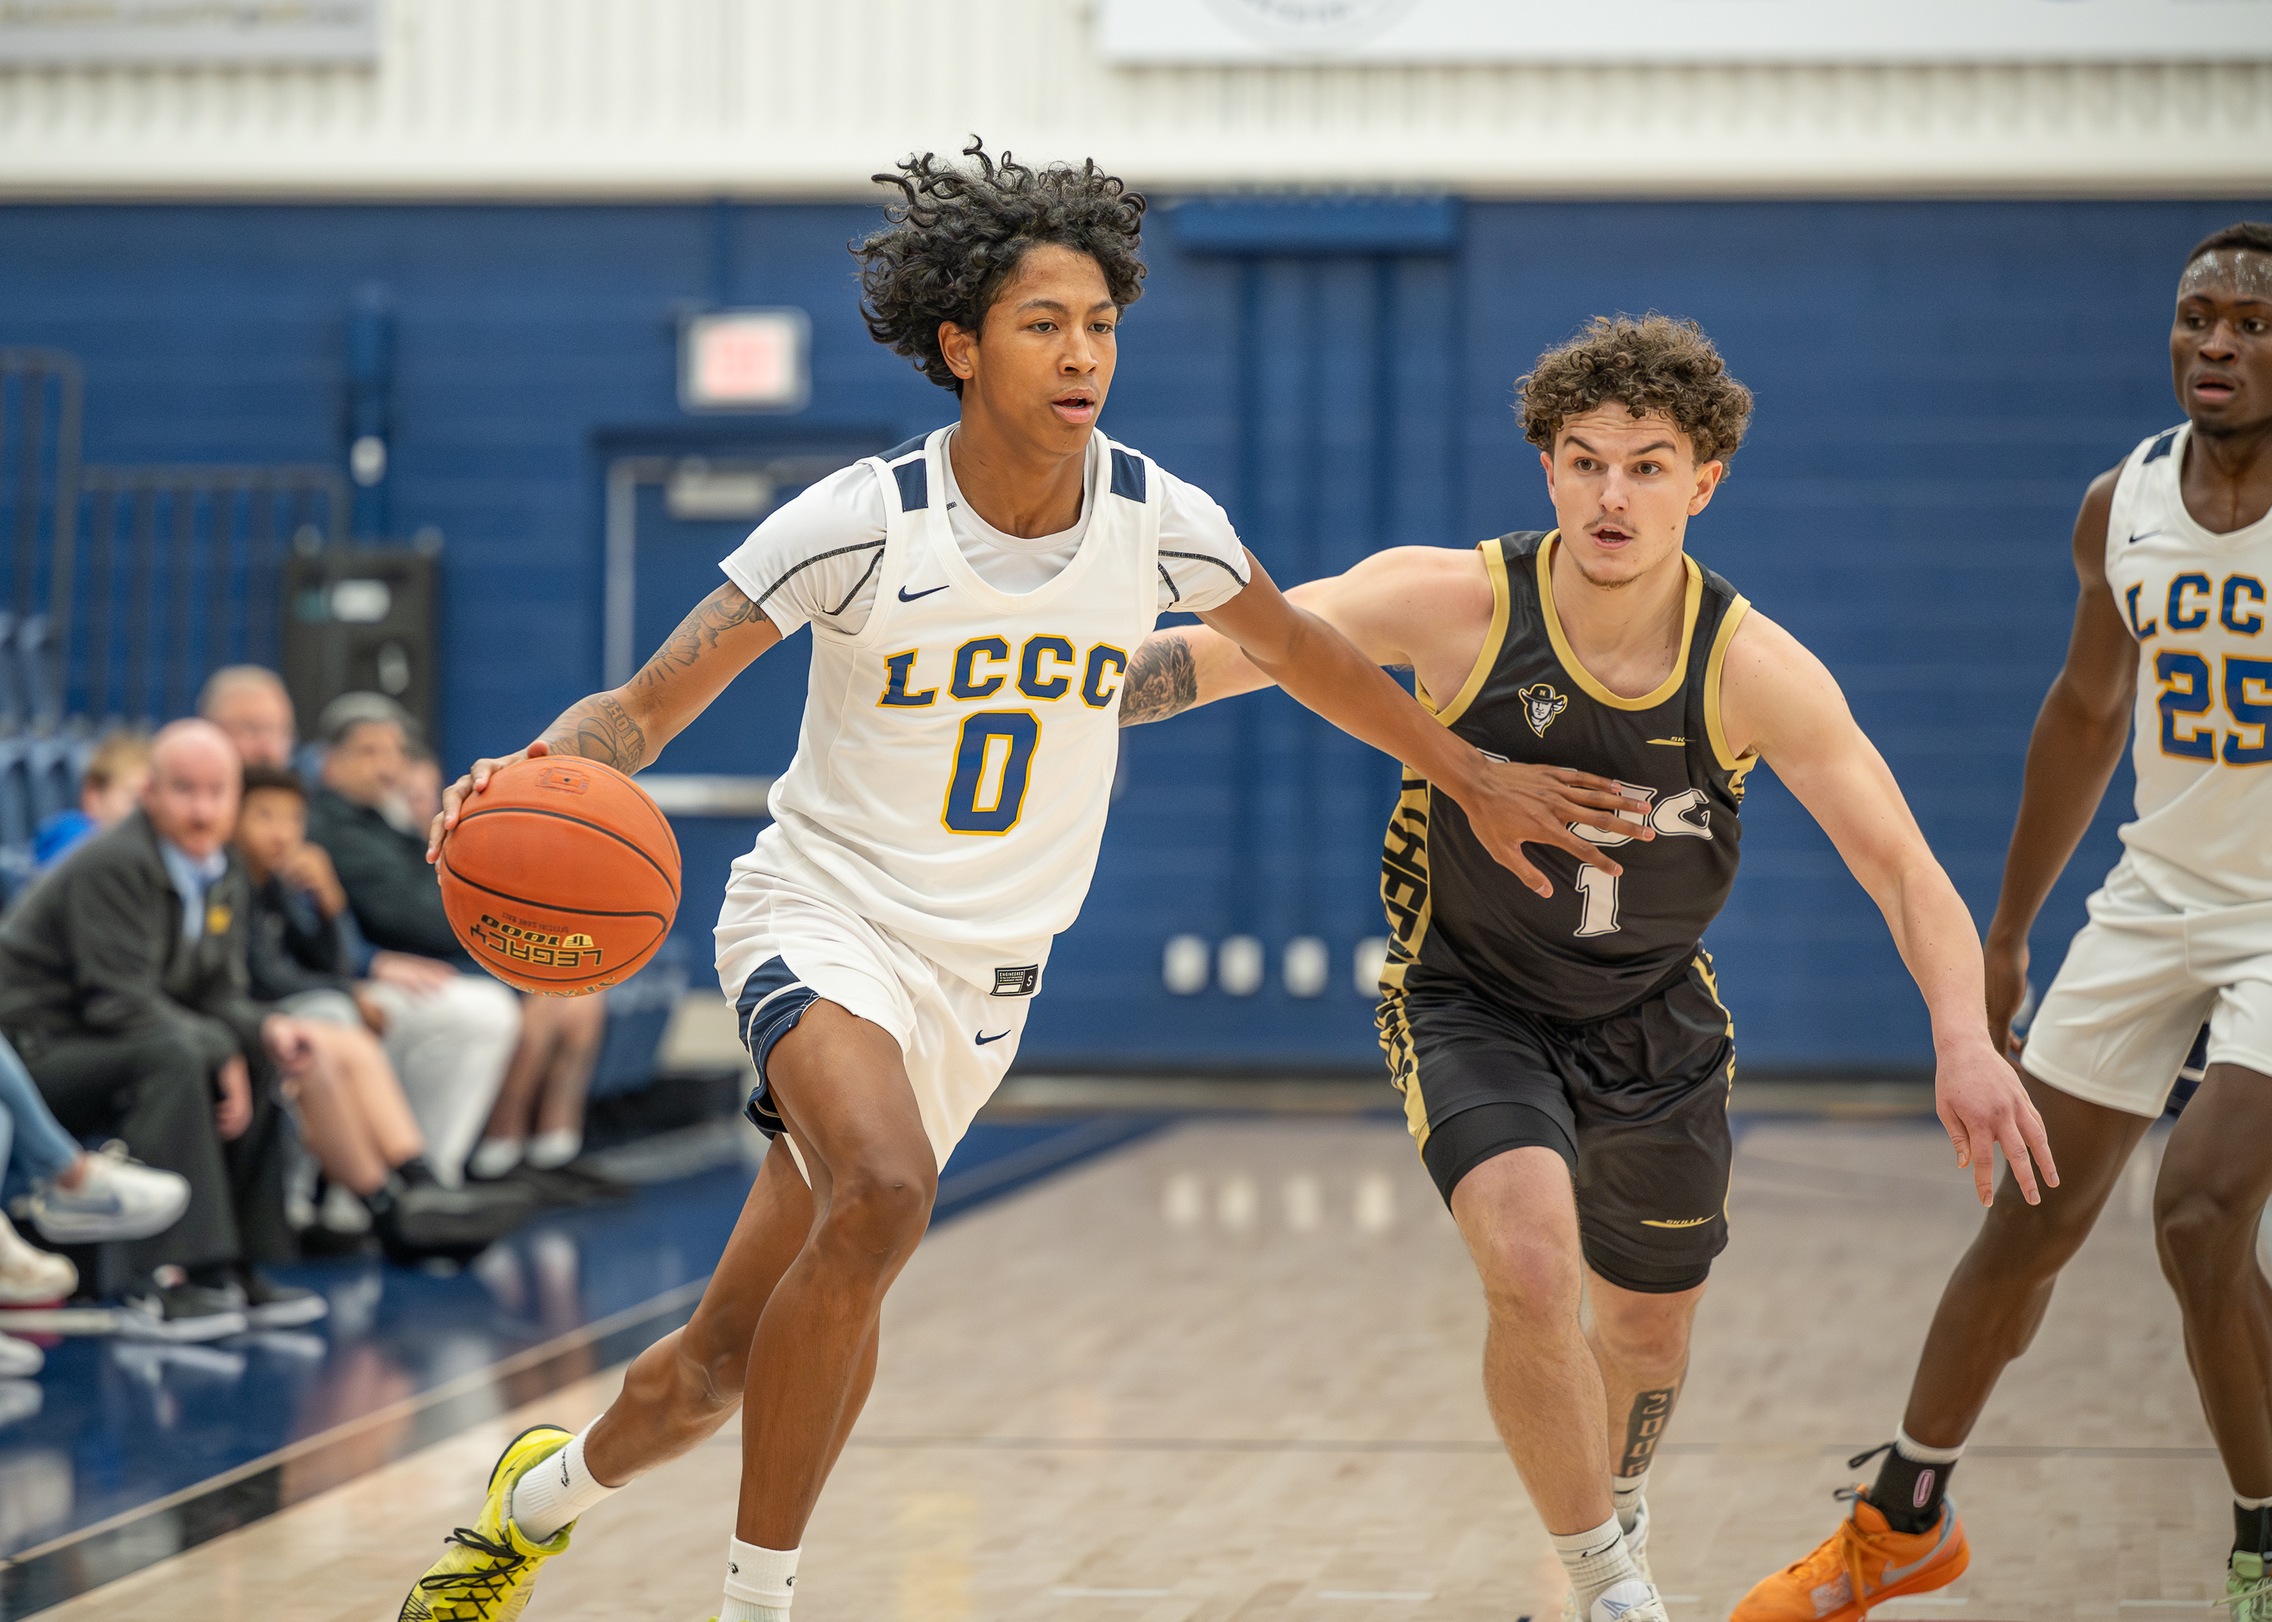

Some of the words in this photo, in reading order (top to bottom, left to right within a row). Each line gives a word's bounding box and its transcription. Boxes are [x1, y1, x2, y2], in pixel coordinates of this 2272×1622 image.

[874, 633, 1129, 710] LCCC
[2152, 647, 2272, 768] 25
[940, 708, 1043, 837] 0
[480, 914, 561, 947] 1000
[1573, 862, 1622, 938] 1
[469, 923, 604, 968] LEGACY
[1026, 975, 1034, 987] S
